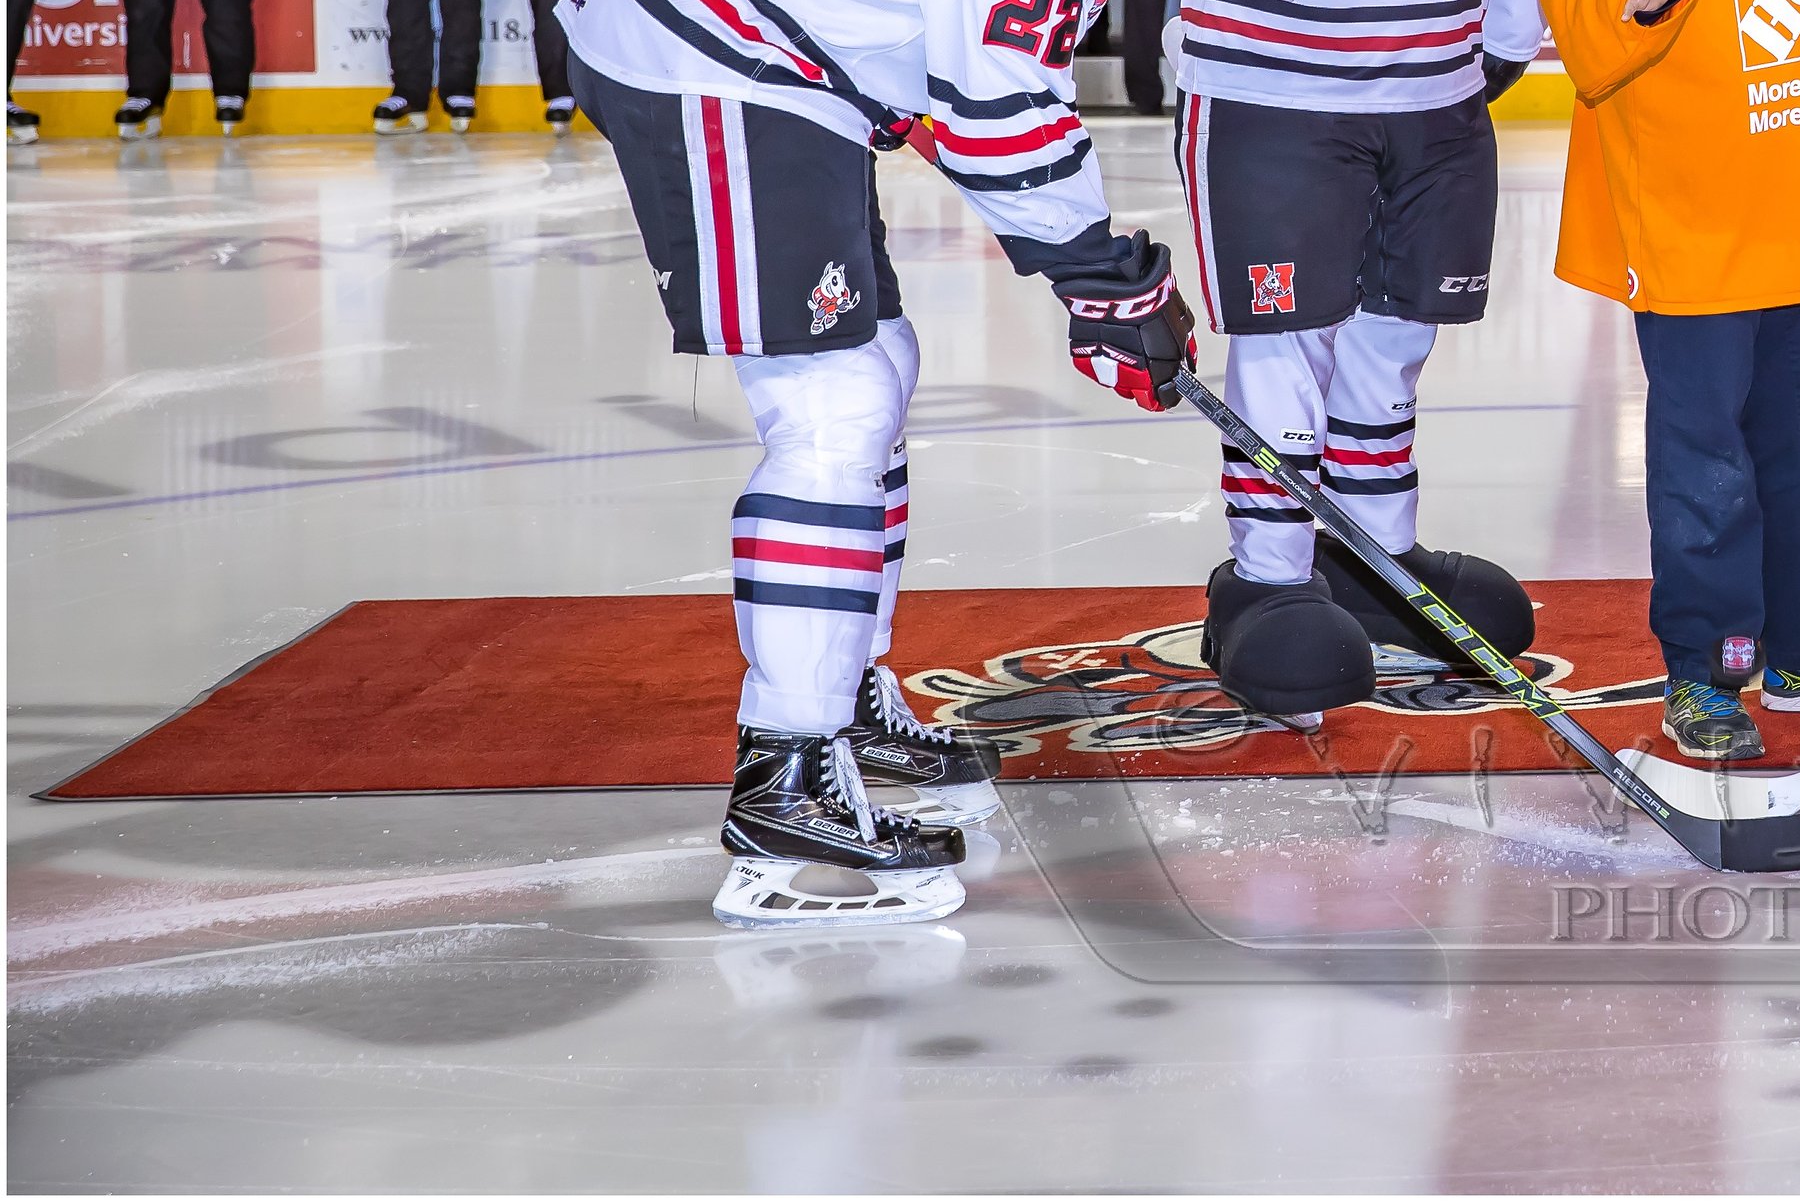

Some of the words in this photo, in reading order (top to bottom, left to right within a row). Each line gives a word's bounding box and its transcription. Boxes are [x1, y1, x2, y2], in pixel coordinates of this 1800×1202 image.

[23, 14, 129, 48] niversi
[1438, 274, 1490, 294] CC
[1406, 581, 1565, 719] CCM
[865, 747, 907, 764] BAUER
[1612, 766, 1671, 820] RIBCORE
[813, 819, 858, 838] BAUER
